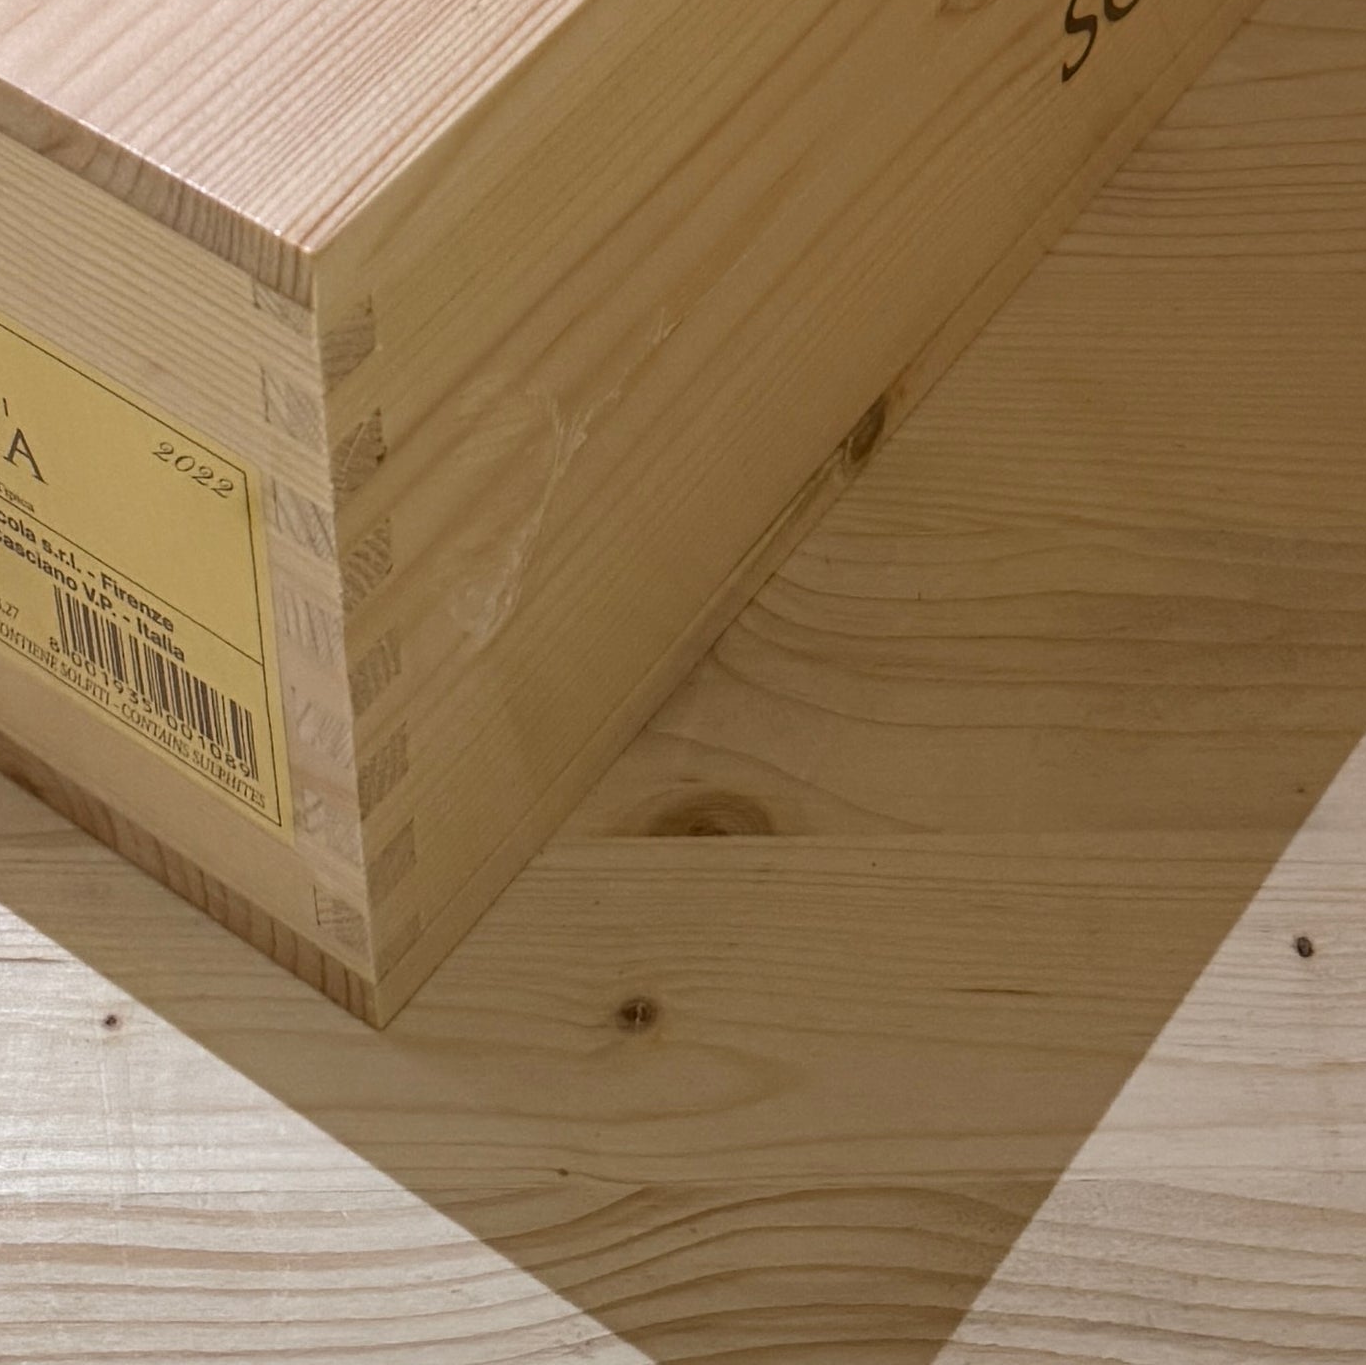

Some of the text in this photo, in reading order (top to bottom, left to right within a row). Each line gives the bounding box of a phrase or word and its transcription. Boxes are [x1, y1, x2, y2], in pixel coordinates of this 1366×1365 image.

[150, 440, 235, 499] 2022
[40, 537, 82, 574] s.r.l.
[99, 570, 174, 634] Firenze
[48, 635, 61, 654] 8
[80, 580, 117, 618] V.P.
[135, 615, 186, 664] Italia
[120, 701, 190, 759] CONTAINS
